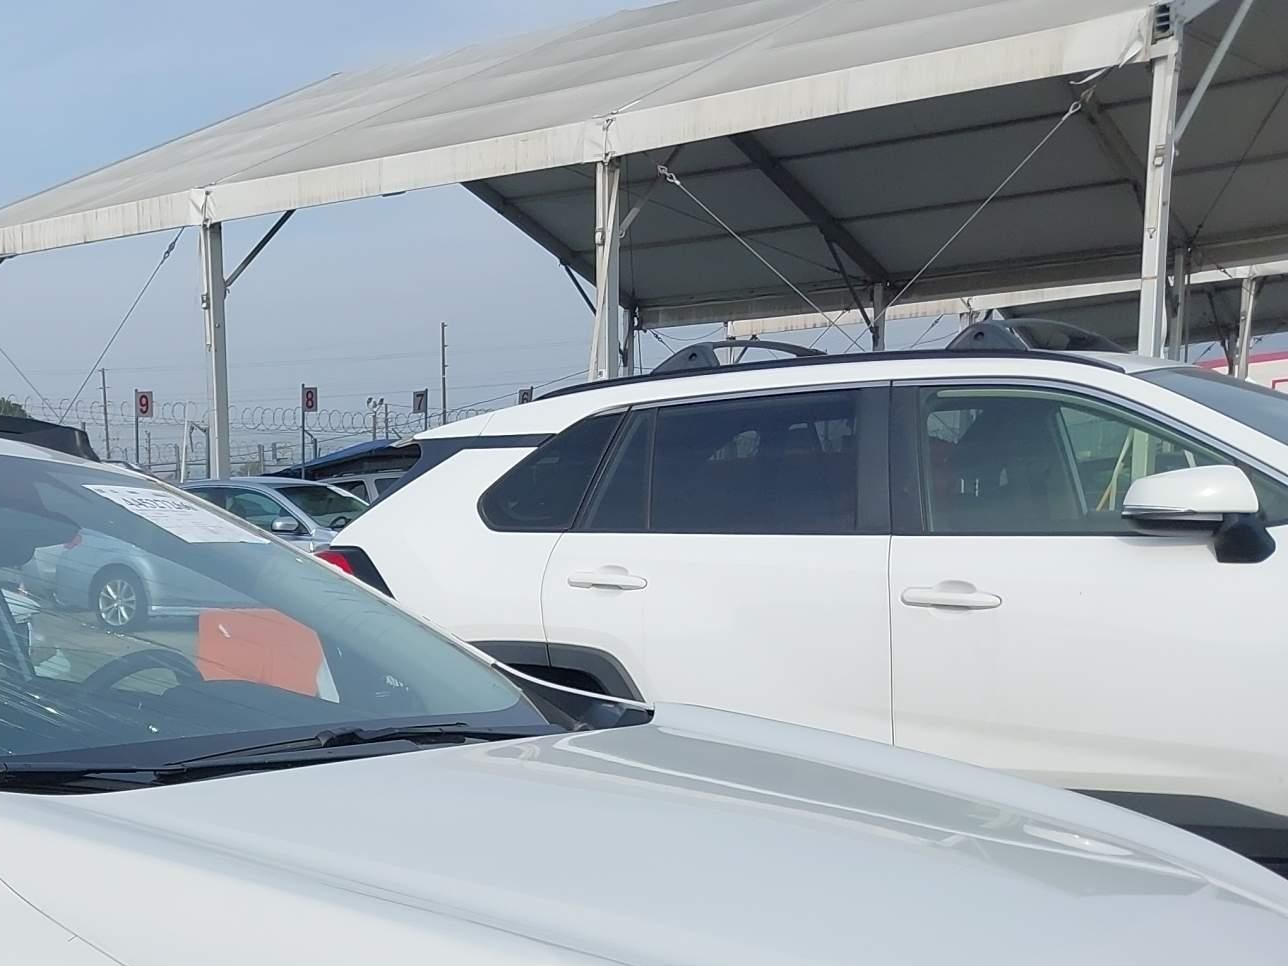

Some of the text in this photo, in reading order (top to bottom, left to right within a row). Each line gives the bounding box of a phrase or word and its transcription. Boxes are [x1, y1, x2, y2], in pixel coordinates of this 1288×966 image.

[138, 394, 149, 414] 9
[305, 390, 314, 409] 8
[415, 393, 425, 410] 7
